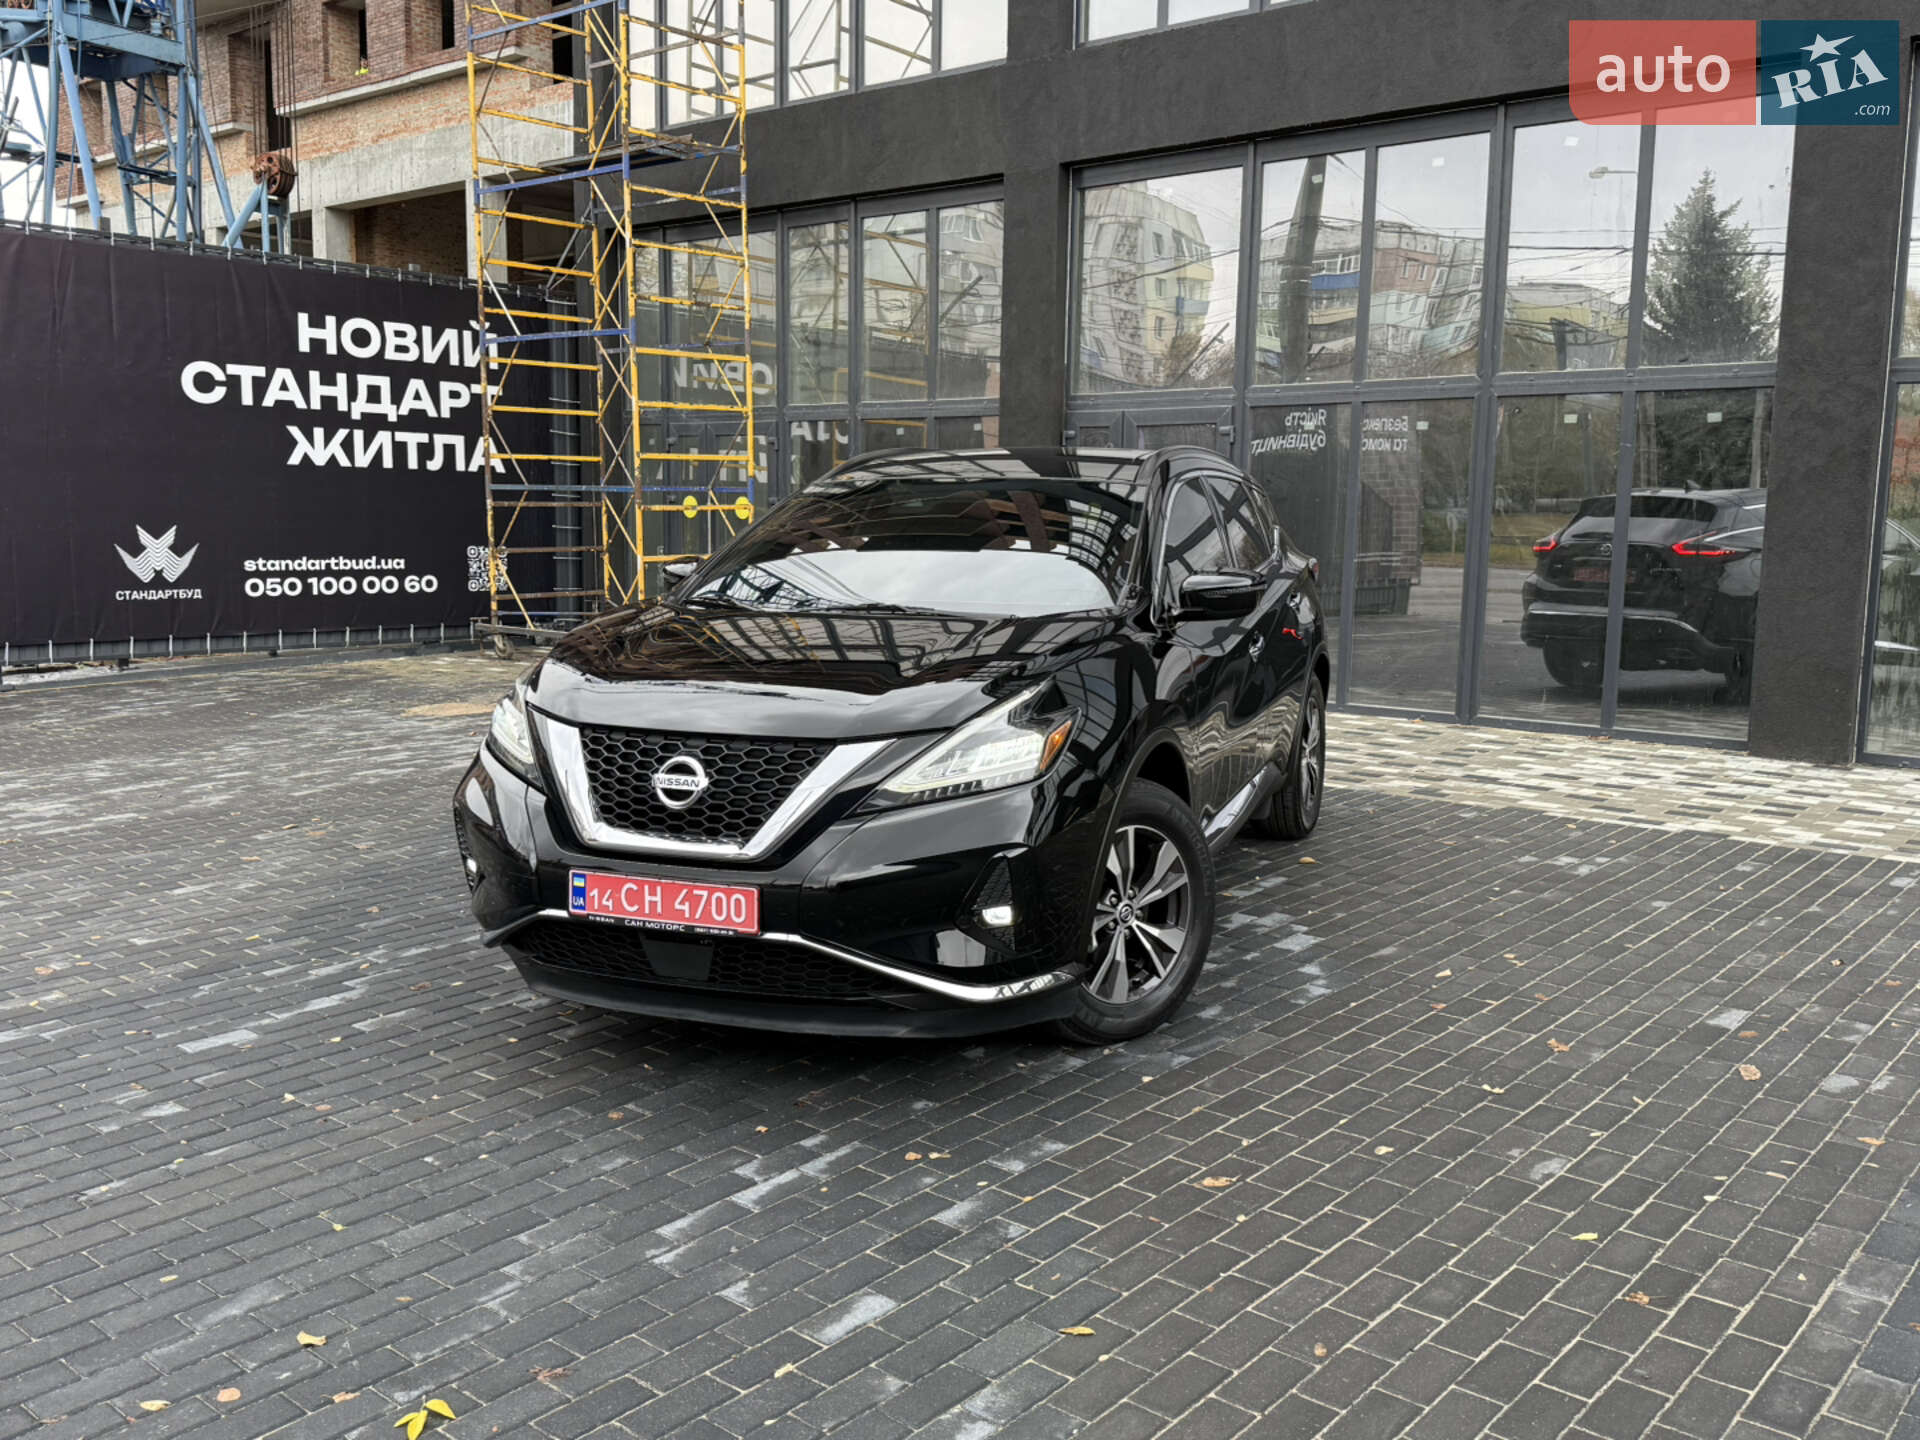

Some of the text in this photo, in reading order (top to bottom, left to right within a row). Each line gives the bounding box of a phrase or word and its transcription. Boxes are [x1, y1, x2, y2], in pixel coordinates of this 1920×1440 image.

[297, 312, 499, 370] НОВИЙ
[180, 360, 503, 422] СТАНДАРТ
[286, 425, 506, 474] ЖИТЛА
[243, 556, 405, 572] standartbud.ua
[115, 588, 202, 600] СТАНДАРТБУД
[244, 575, 438, 597] 050 100 00 60
[655, 776, 700, 788] NISSAN
[573, 896, 585, 906] UA
[589, 888, 614, 912] 14
[674, 888, 747, 924] 4700
